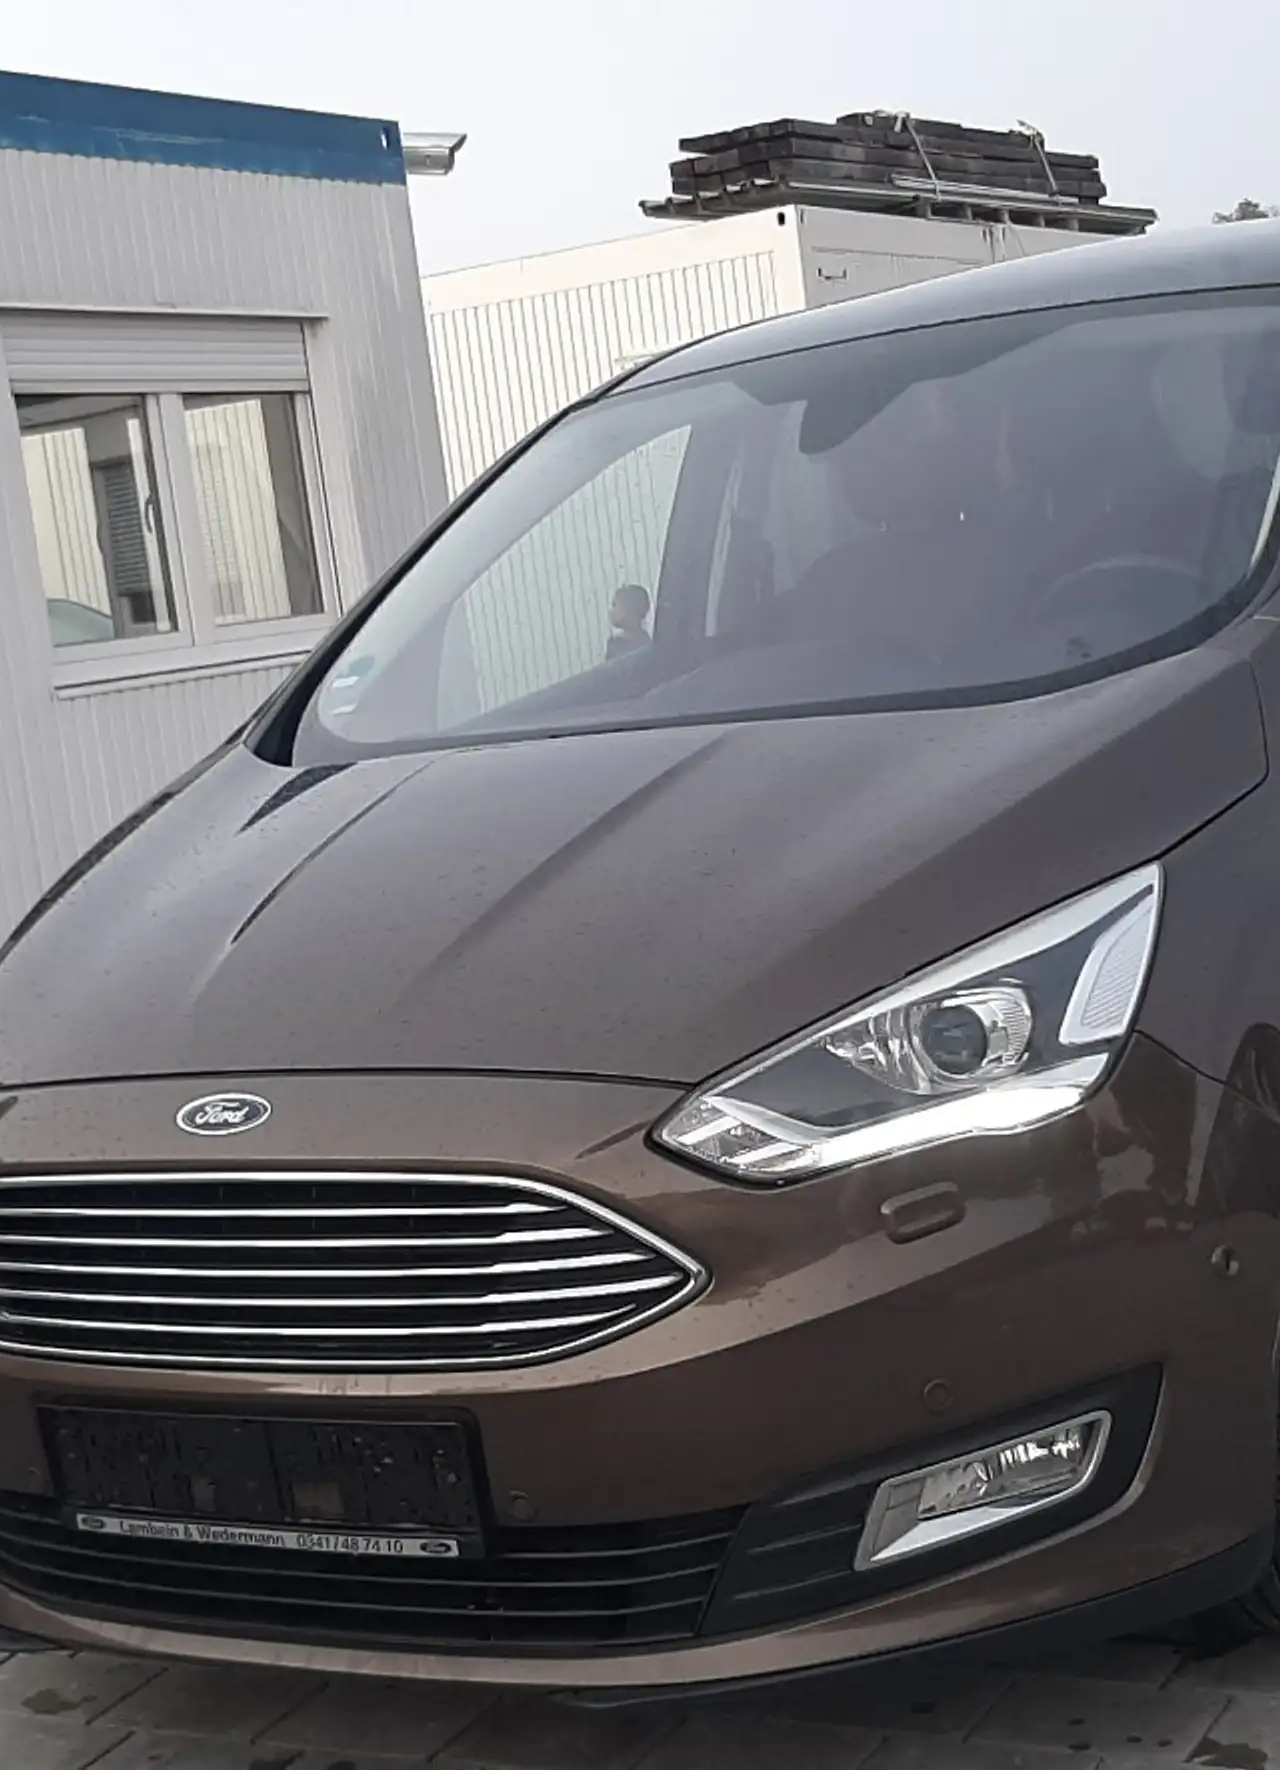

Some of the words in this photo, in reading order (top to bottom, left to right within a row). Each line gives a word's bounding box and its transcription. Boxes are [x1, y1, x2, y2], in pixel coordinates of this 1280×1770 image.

[195, 1101, 249, 1125] Ford
[363, 1537, 381, 1552] 74
[386, 1539, 404, 1553] 10
